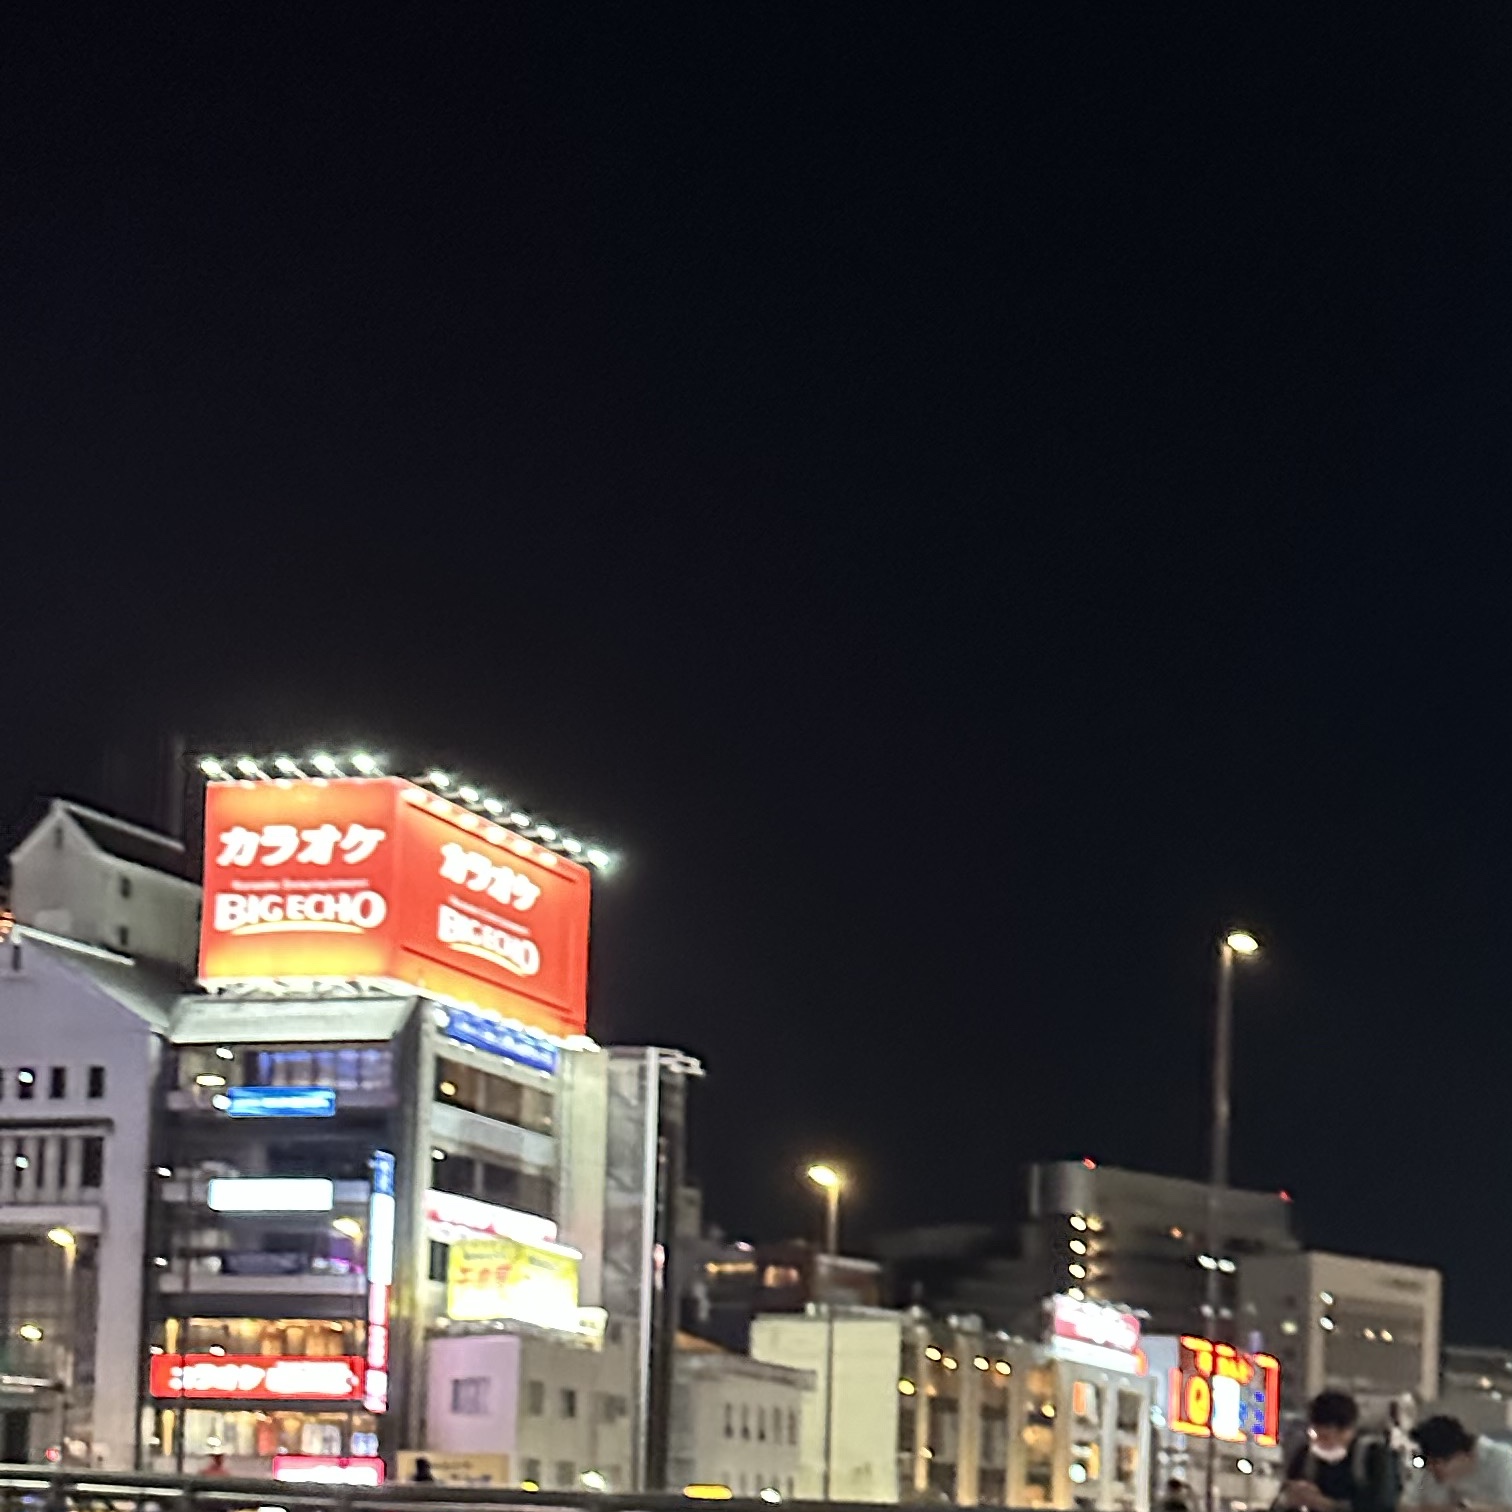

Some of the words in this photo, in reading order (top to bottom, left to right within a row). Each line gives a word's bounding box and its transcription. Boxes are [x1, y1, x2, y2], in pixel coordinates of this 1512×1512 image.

[216, 823, 386, 867] カラオケ
[440, 842, 541, 911] カラオケ
[214, 892, 285, 932] BIG
[285, 890, 388, 928] ECHO
